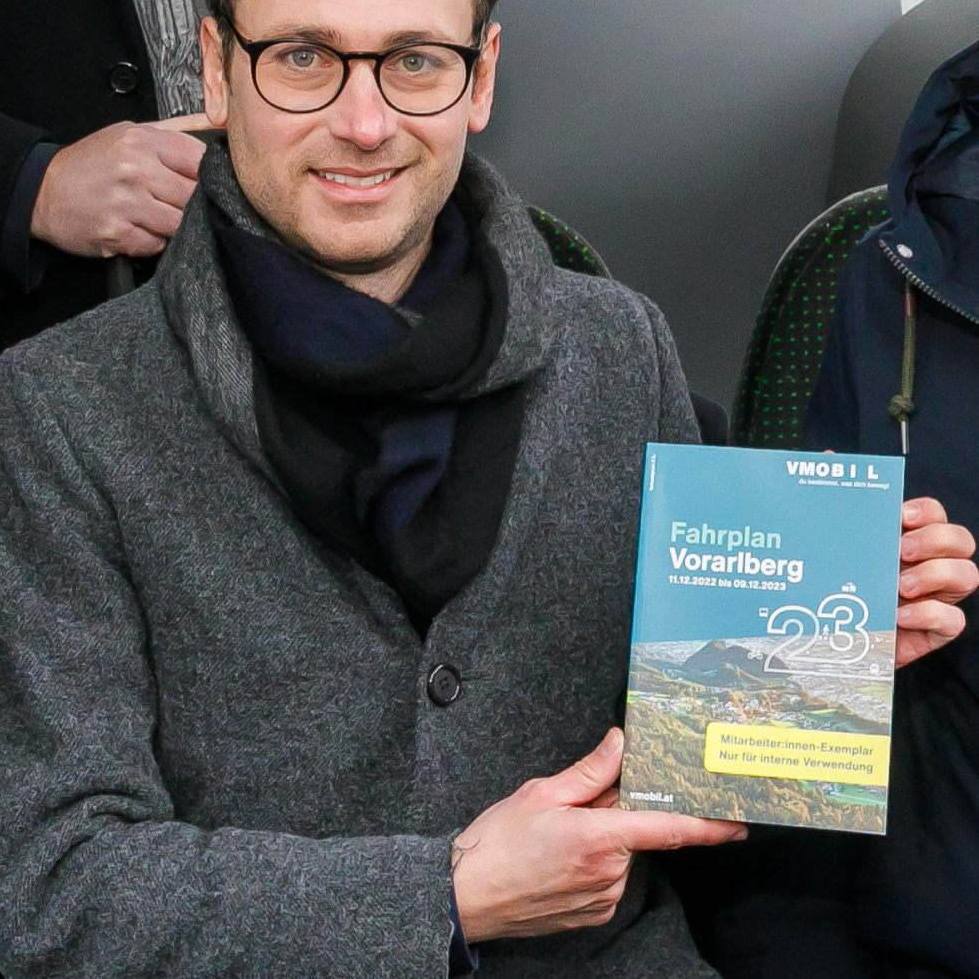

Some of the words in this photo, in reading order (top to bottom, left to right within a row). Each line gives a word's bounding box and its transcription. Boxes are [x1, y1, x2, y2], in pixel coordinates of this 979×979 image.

[671, 521, 782, 552] Fahrplan
[669, 547, 804, 583] Vorarlberg
[668, 574, 717, 587] 11.12.2022
[717, 578, 732, 588] bis
[733, 579, 787, 591] 09.12.2023
[764, 593, 869, 673] 23
[720, 735, 874, 757] Mitarbeiter:innen-Exemplar
[719, 751, 739, 761] Nur
[742, 752, 757, 762] für
[760, 754, 799, 766] interne
[803, 757, 874, 774] Verwendung
[630, 791, 674, 803] vmobil.at
